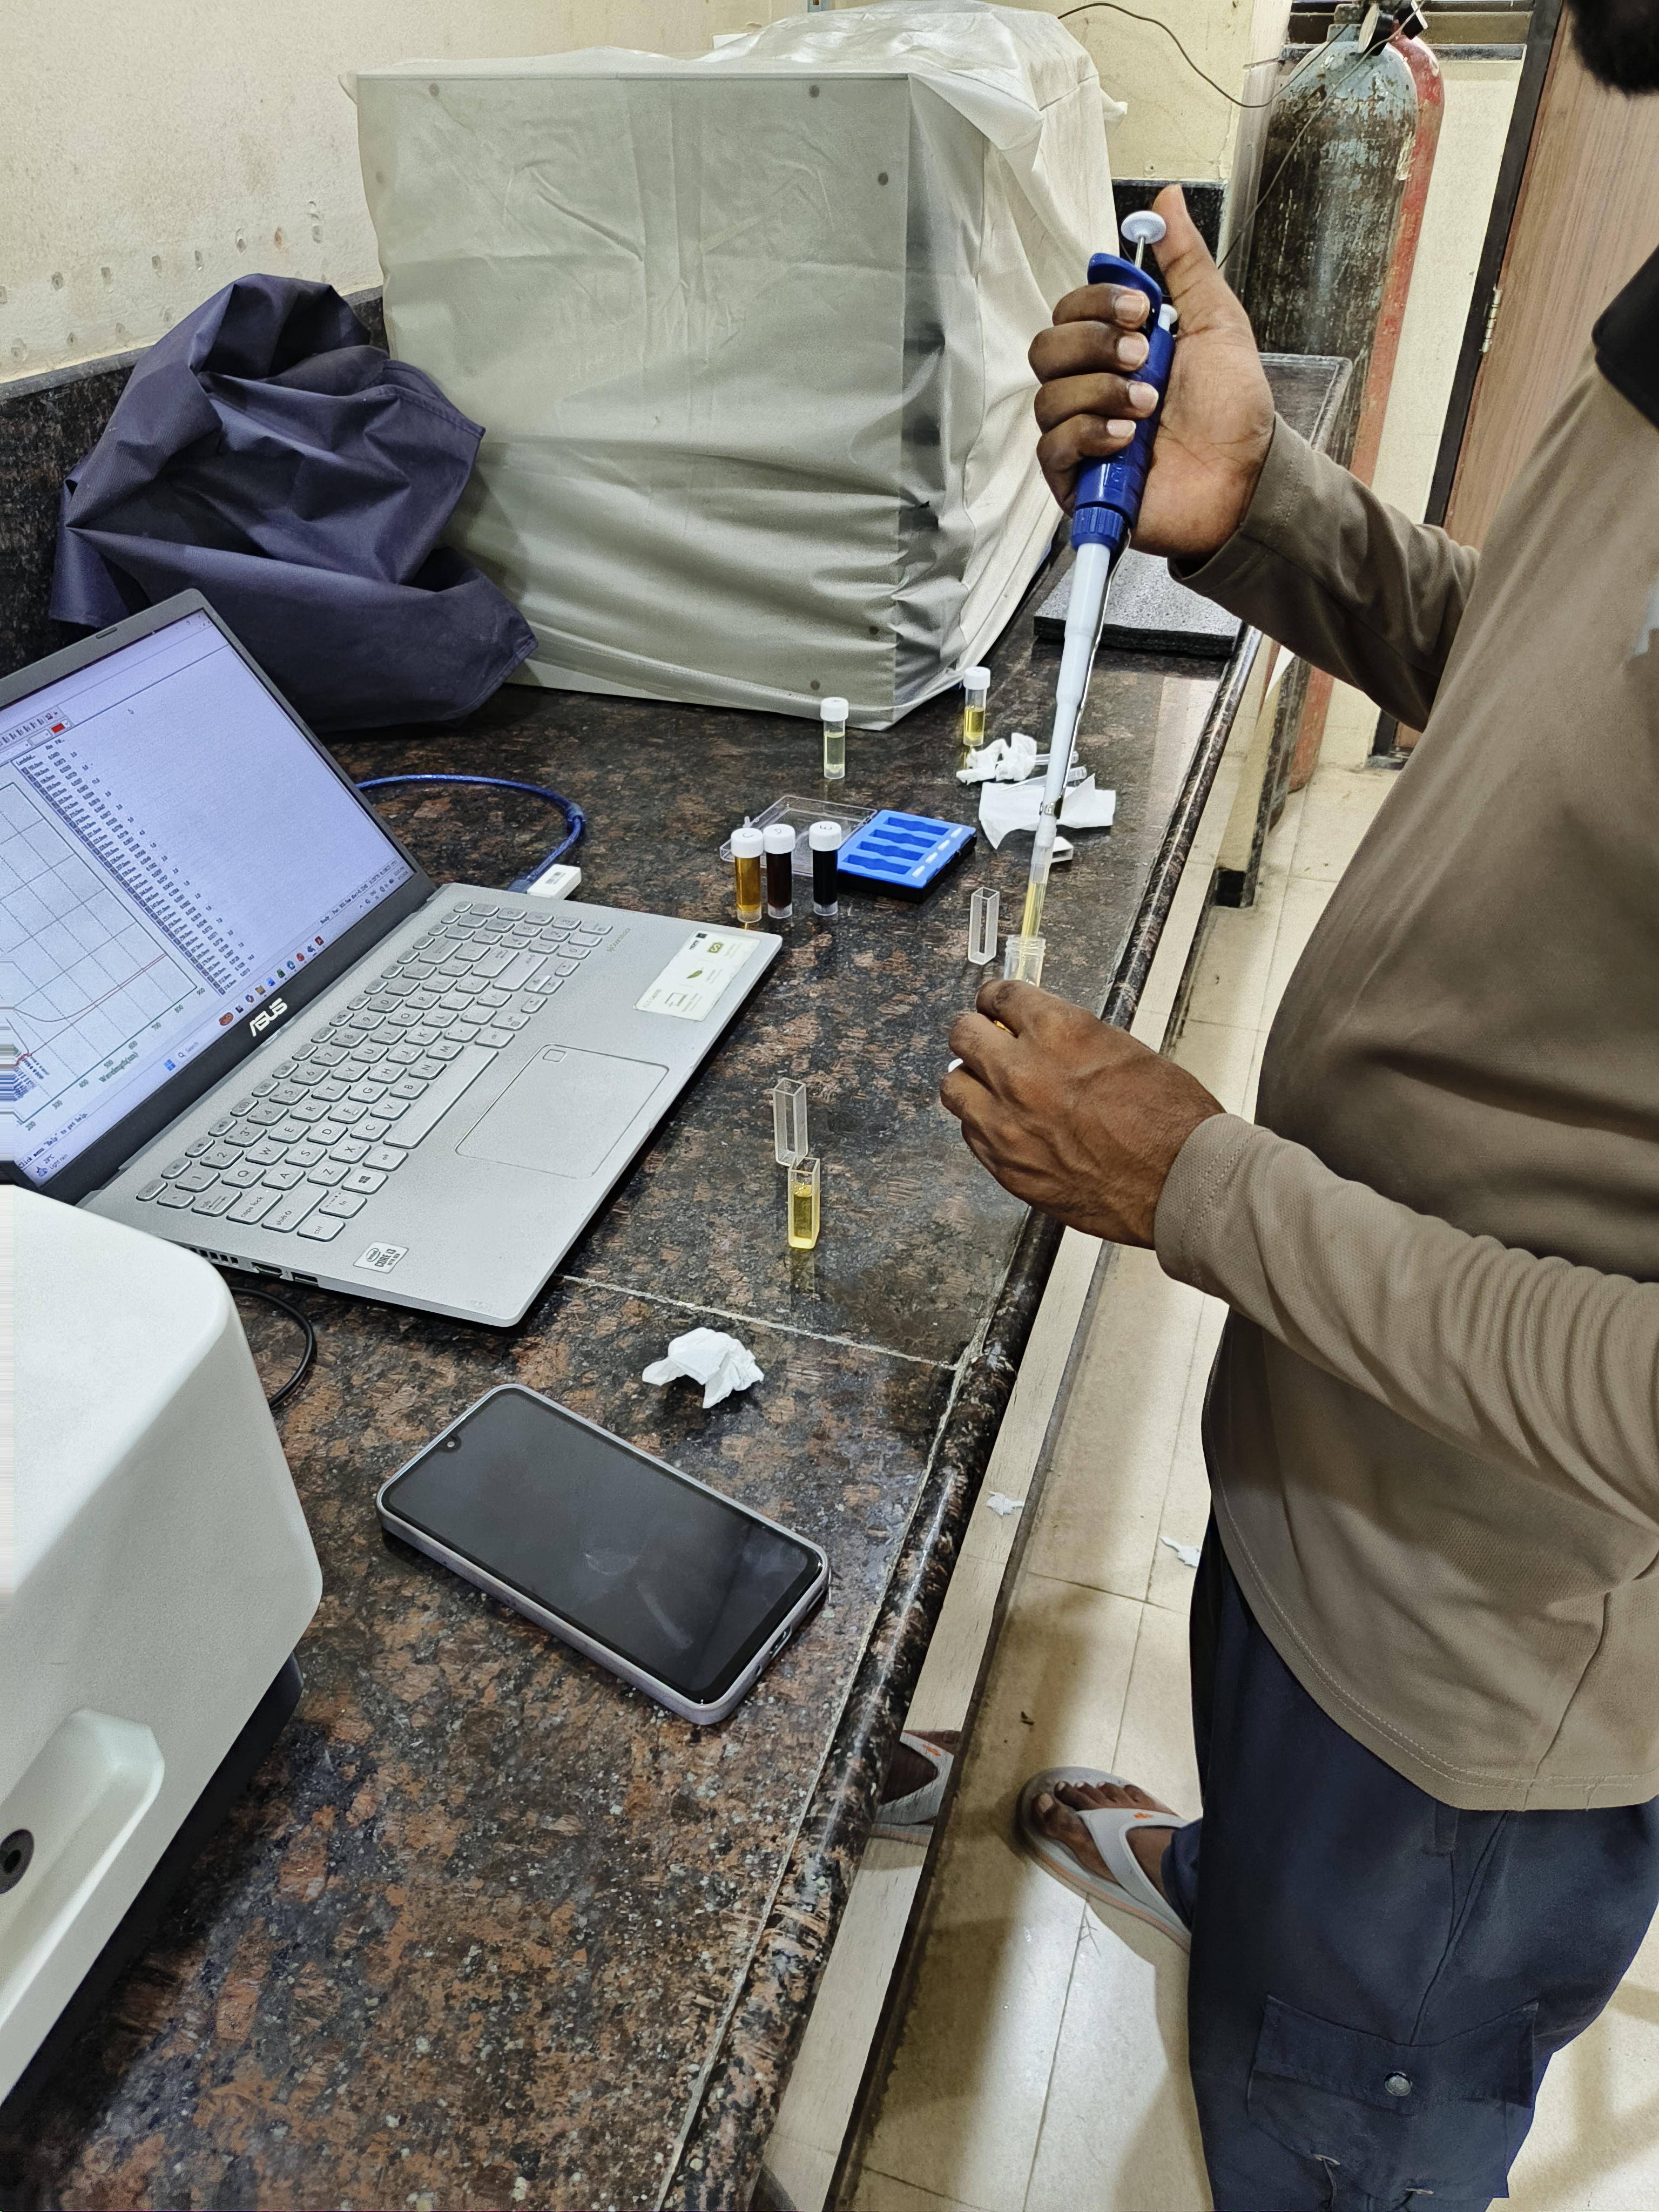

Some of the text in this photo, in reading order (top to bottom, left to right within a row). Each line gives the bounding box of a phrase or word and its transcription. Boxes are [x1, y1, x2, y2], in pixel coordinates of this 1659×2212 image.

[196, 987, 205, 996] 900
[174, 1004, 184, 1013] 800
[249, 998, 287, 1037] ASUS
[151, 1022, 161, 1031] 700
[128, 1040, 138, 1050] 600
[185, 1042, 199, 1053] Search
[104, 1060, 114, 1069] 500
[259, 1147, 272, 1155] W
[18, 1156, 32, 1169] Click
[49, 1159, 60, 1170] Light
[241, 1196, 264, 1218] caps lock
[314, 1225, 323, 1235] ctrl
[374, 1254, 392, 1267] CORE
